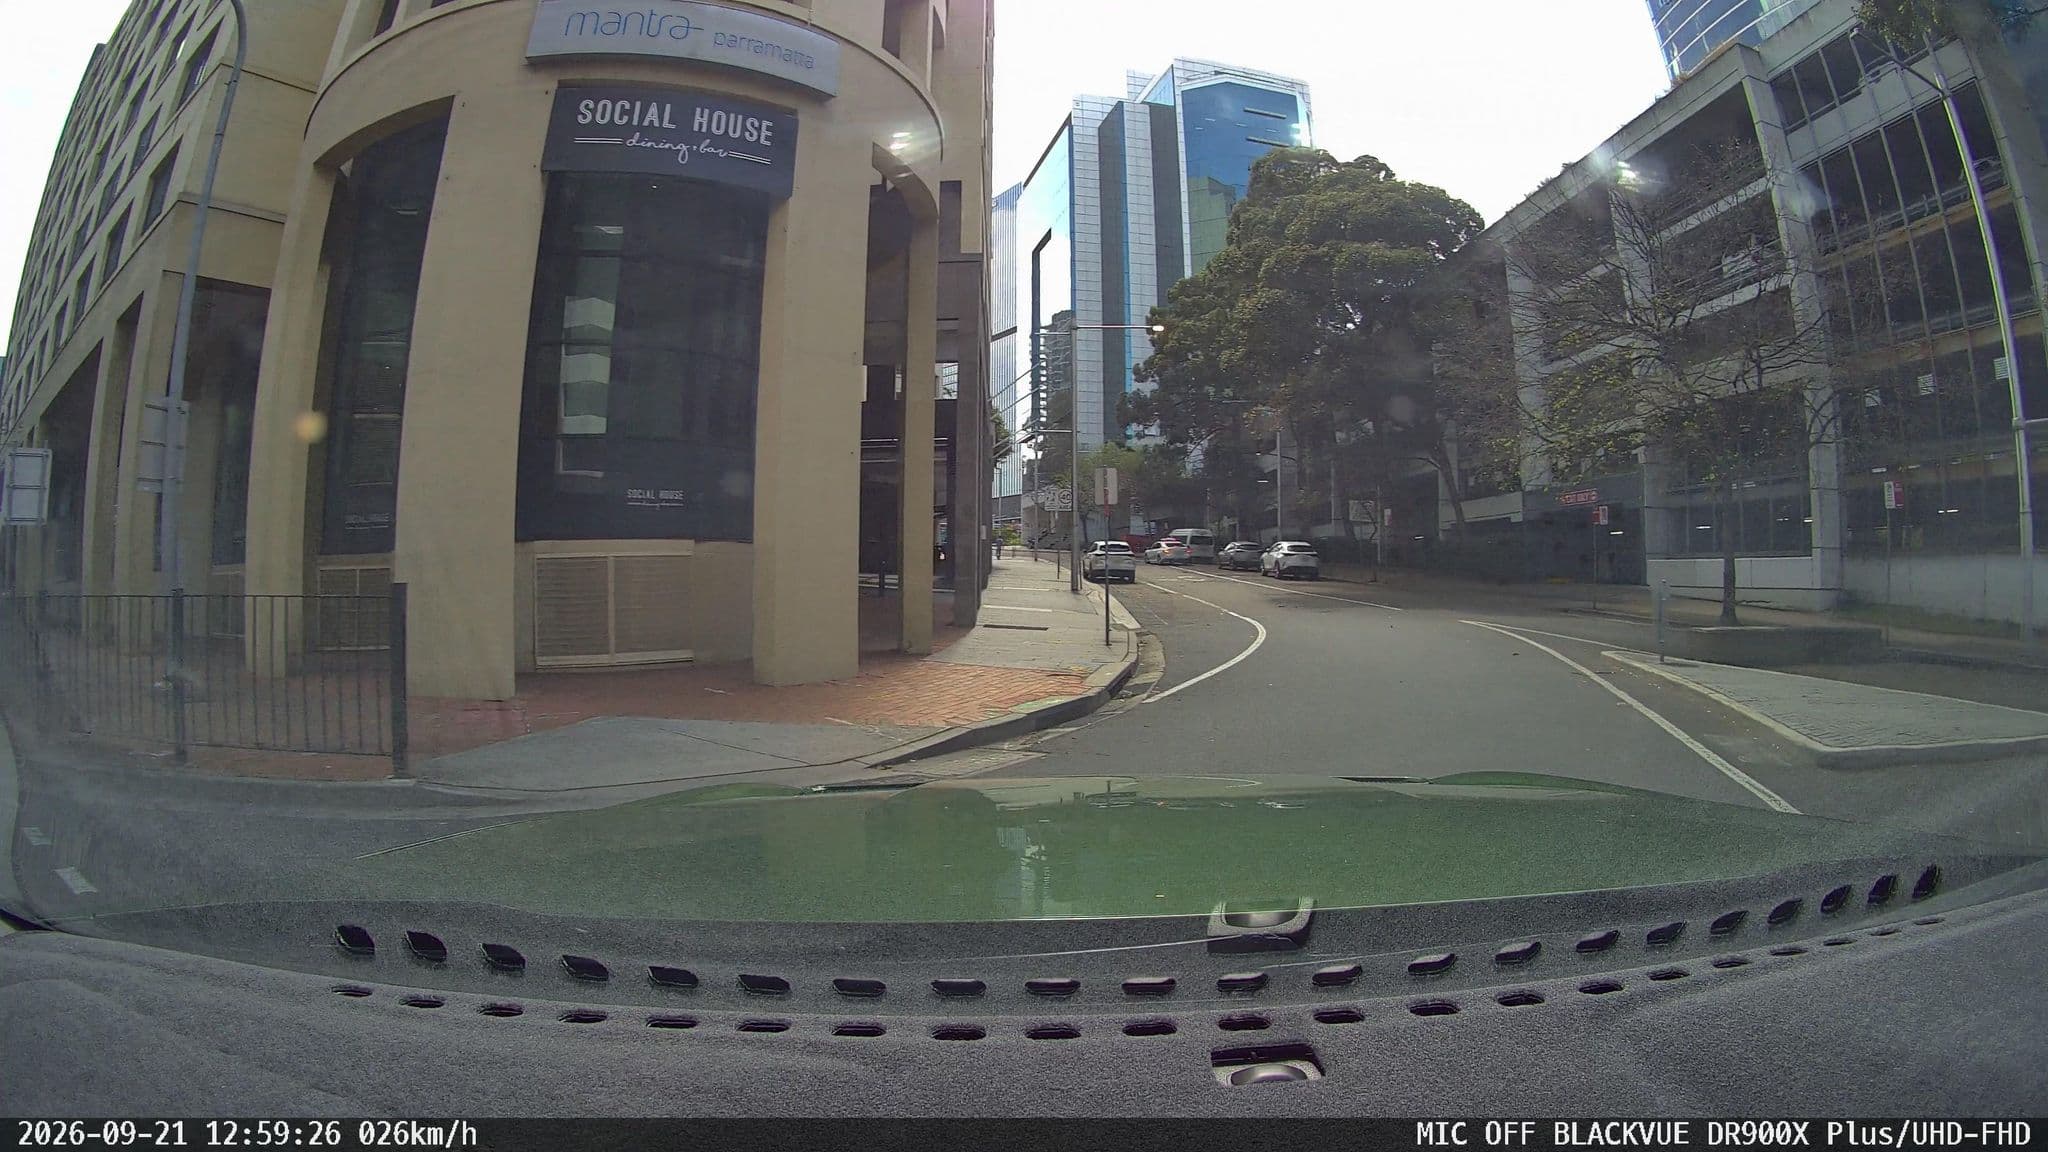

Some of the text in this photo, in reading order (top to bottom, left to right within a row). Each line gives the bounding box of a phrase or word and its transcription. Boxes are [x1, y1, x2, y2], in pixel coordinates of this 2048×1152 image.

[564, 9, 816, 69] mantra parramatta
[577, 99, 774, 146] SOCIAL HOUSE
